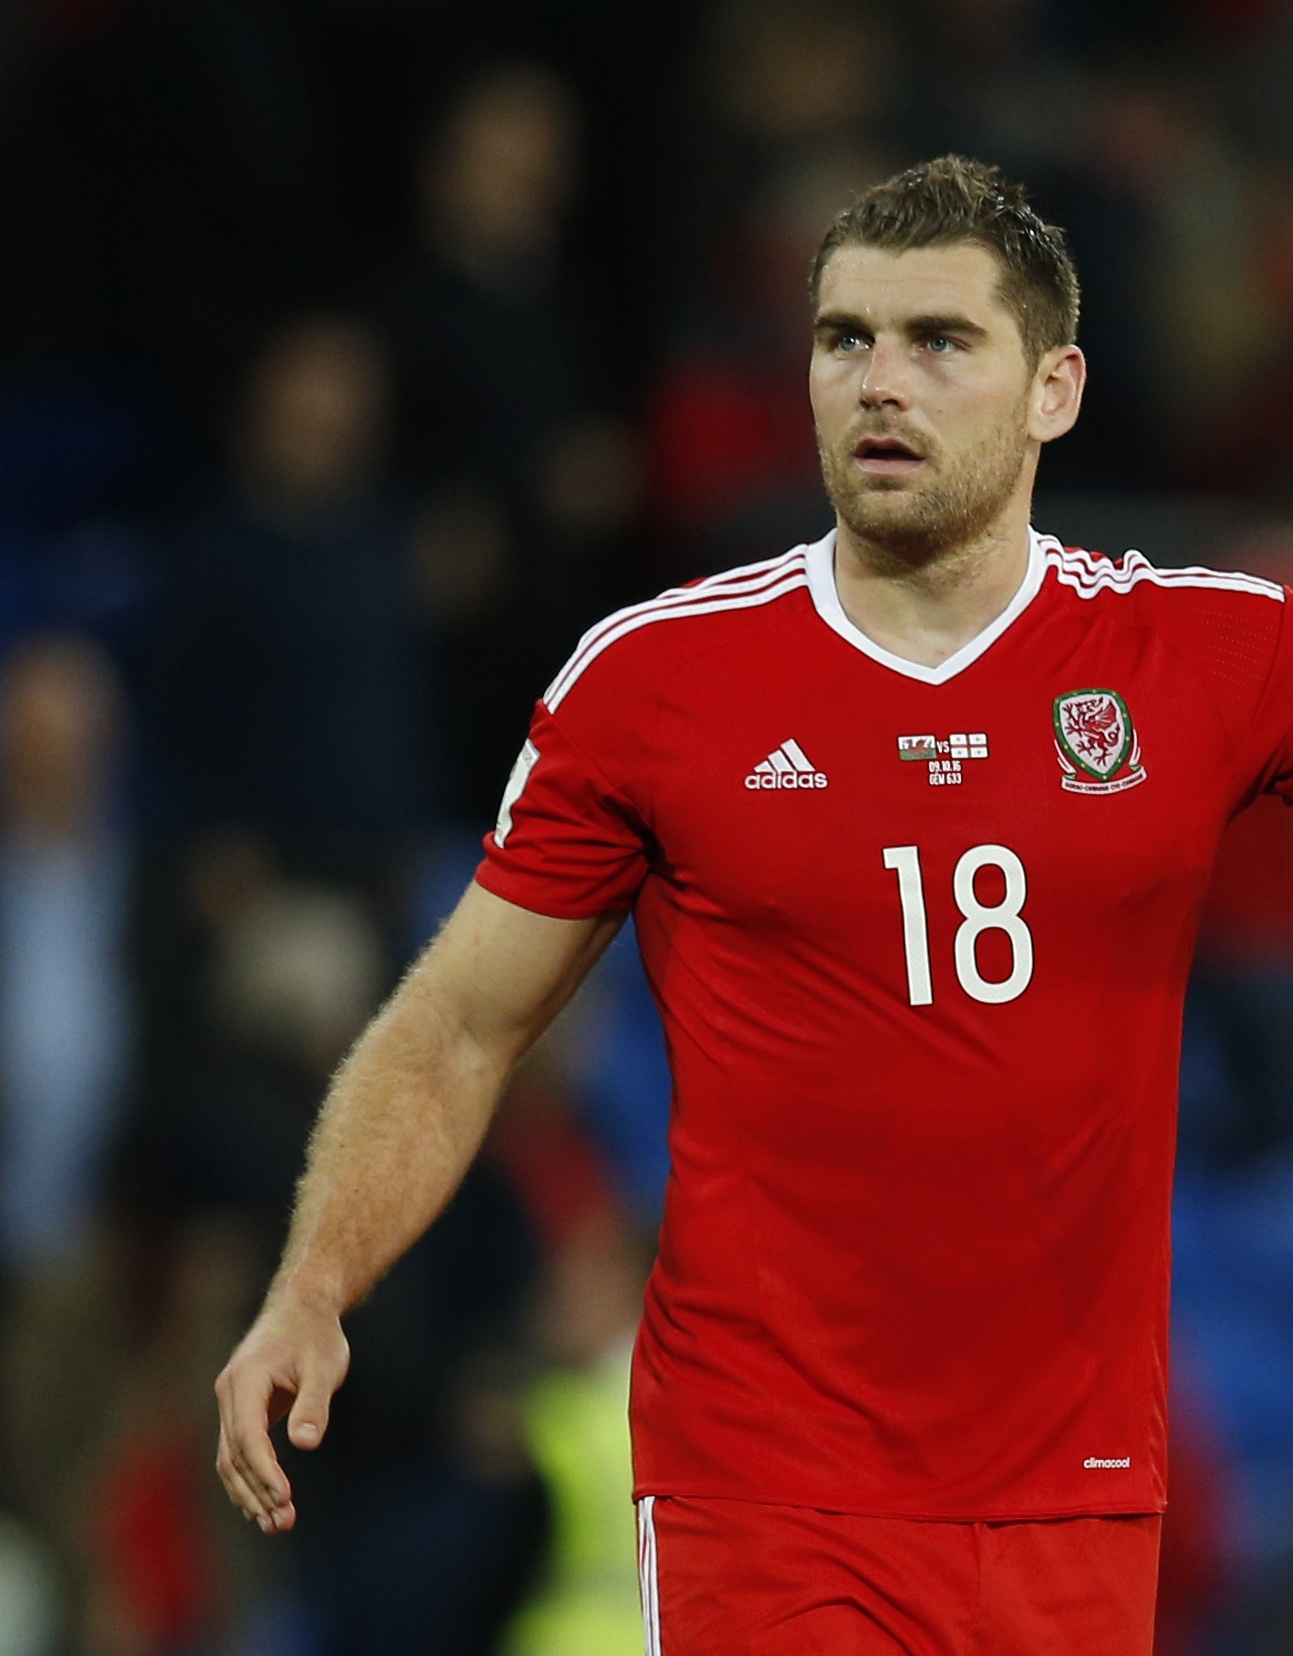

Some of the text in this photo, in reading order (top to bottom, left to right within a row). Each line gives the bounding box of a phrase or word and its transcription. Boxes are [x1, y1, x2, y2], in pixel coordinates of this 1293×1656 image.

[744, 771, 828, 790] adidas
[883, 844, 1034, 1006] 18
[1083, 1456, 1130, 1469] climacool
